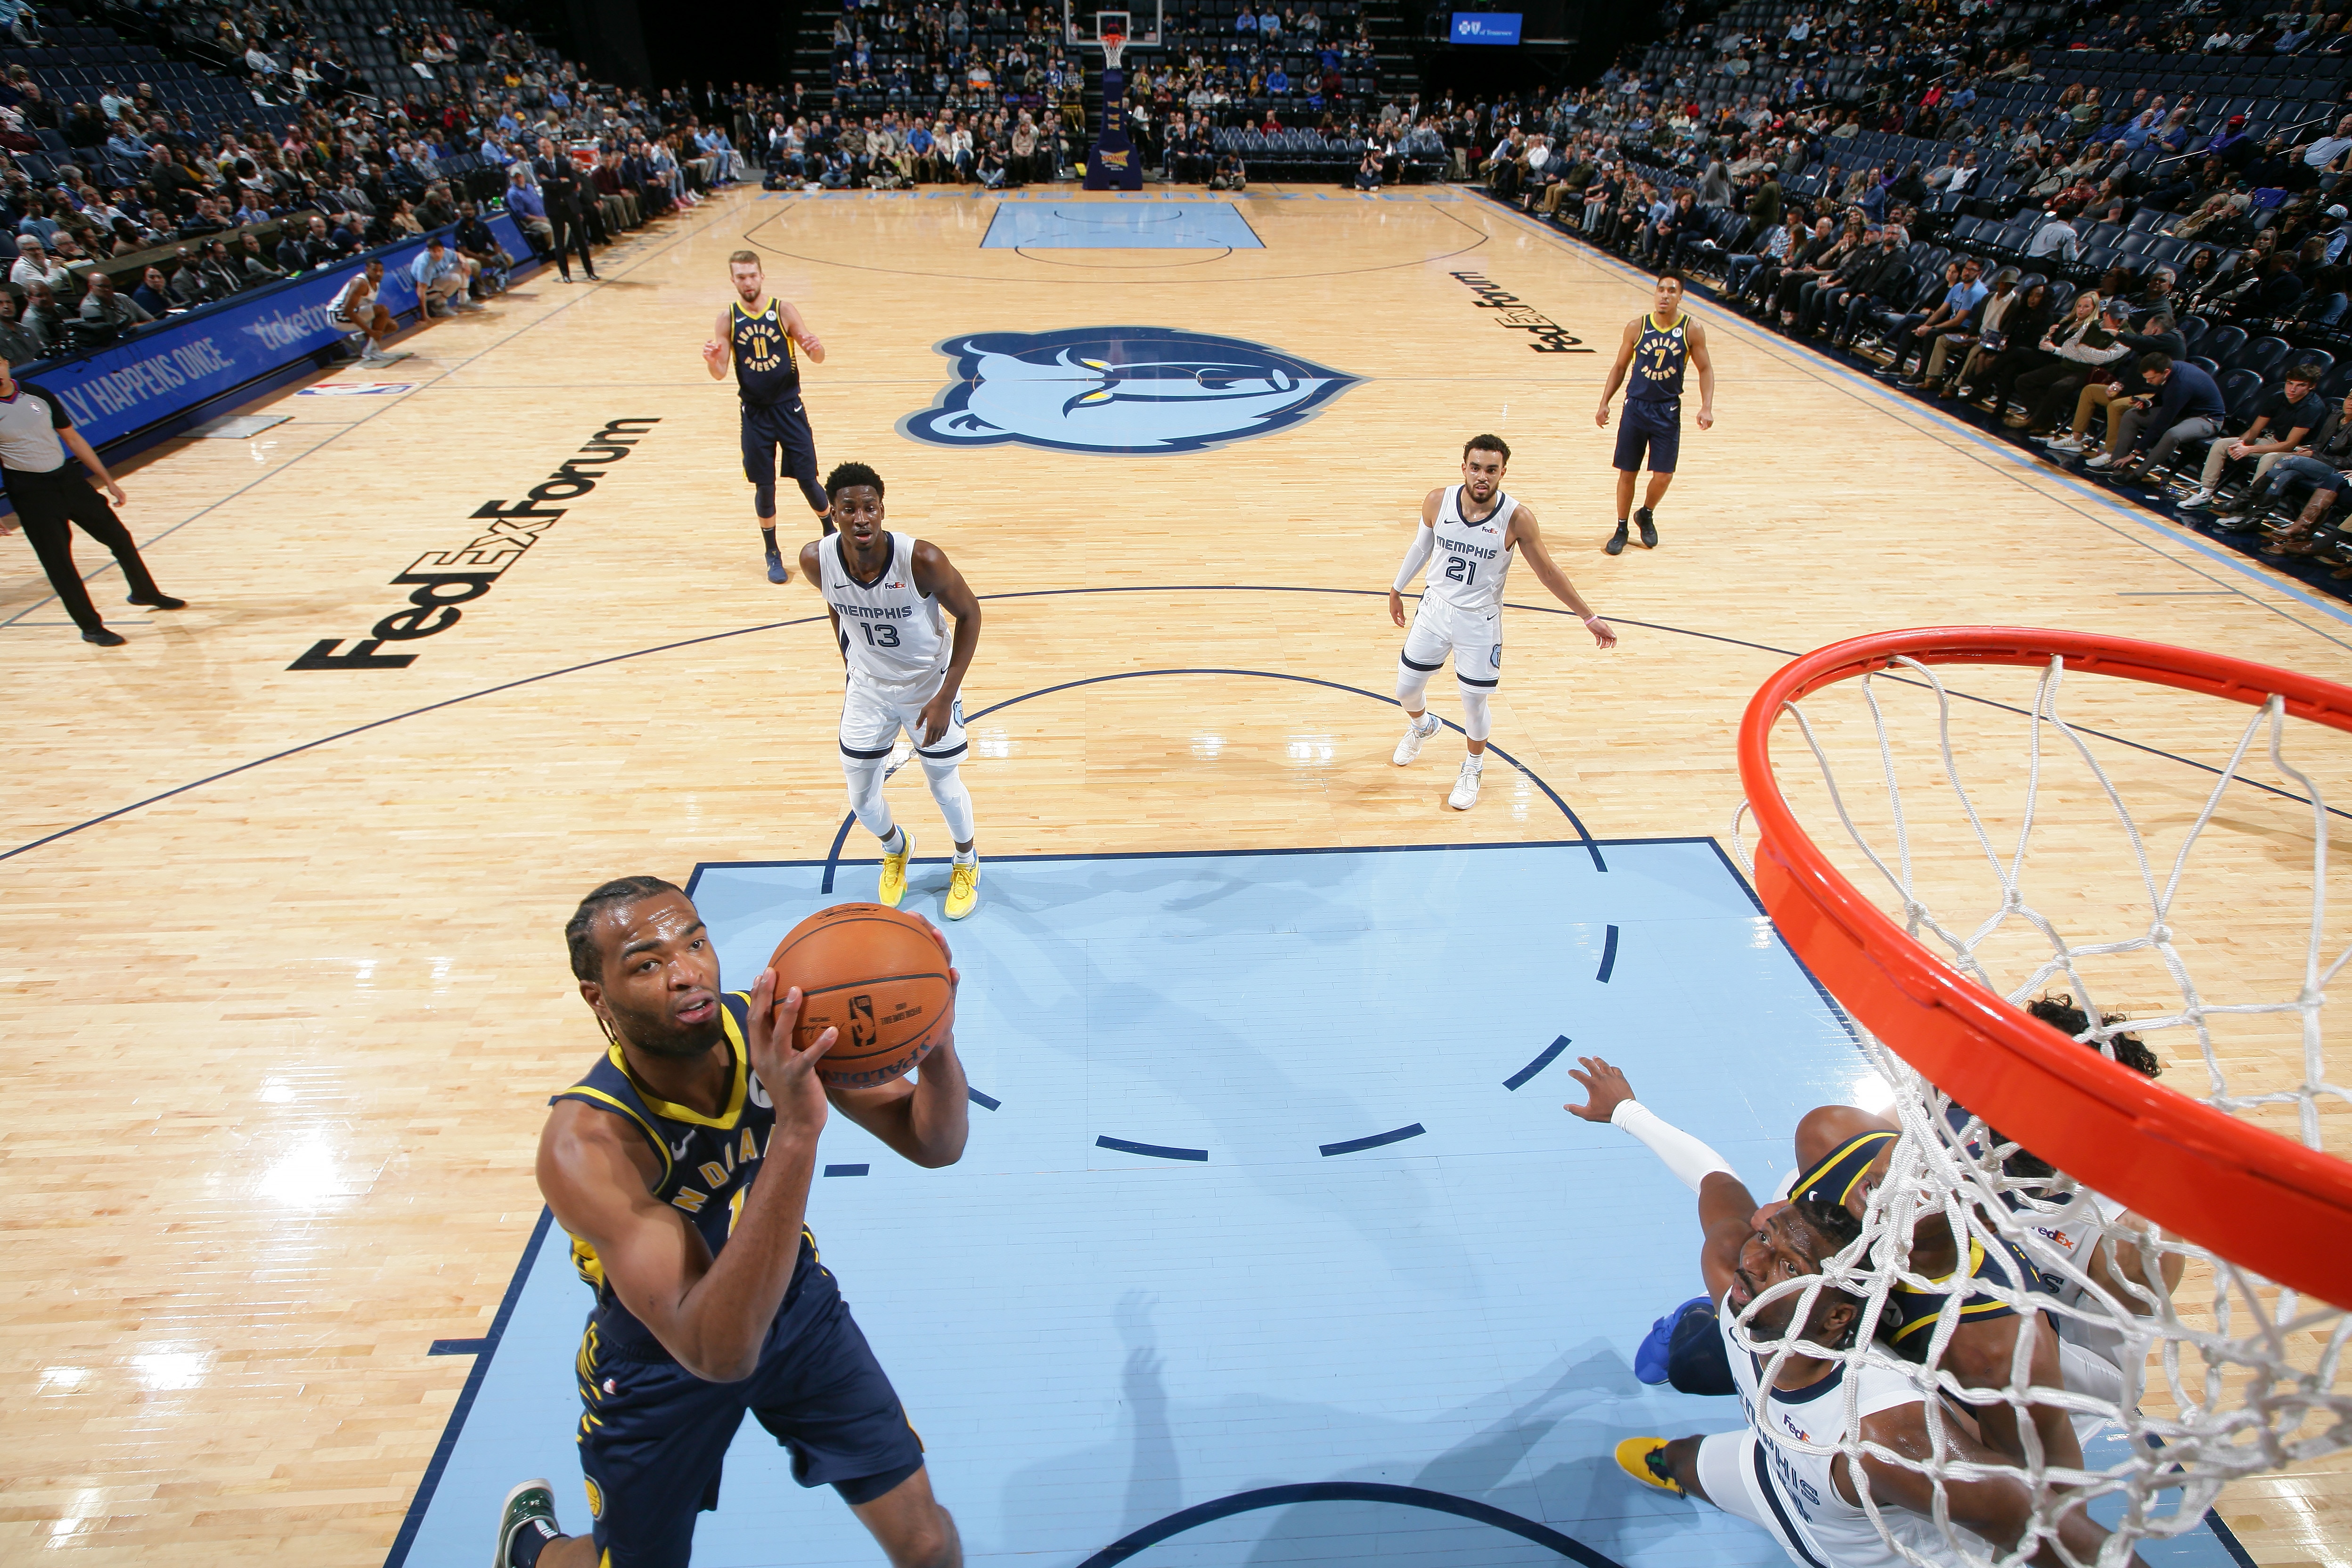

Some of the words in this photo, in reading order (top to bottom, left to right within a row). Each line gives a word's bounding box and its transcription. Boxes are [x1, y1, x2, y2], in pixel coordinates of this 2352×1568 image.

[1449, 272, 1598, 353] FedExForum
[253, 303, 333, 351] ticketm
[737, 324, 781, 345] INDIANA
[753, 337, 768, 359] 11
[1640, 337, 1681, 356] INDIANA
[744, 354, 781, 372] PACERS
[1654, 349, 1666, 369] 7
[54, 386, 98, 429] LY
[82, 354, 185, 416] HAPPENS
[172, 337, 235, 380] ONCE.
[1641, 365, 1677, 381] PACERS
[1482, 526, 1499, 535] FedEx
[285, 417, 662, 671] FedExForum
[1437, 535, 1497, 559] MEMPHIS
[1446, 556, 1477, 585] 21
[833, 603, 912, 619] MEMPHIS
[859, 622, 901, 647] 13
[821, 1034, 931, 1084] SPALDIN
[671, 1124, 776, 1214] NDIA
[1783, 1413, 1812, 1443] FedE
